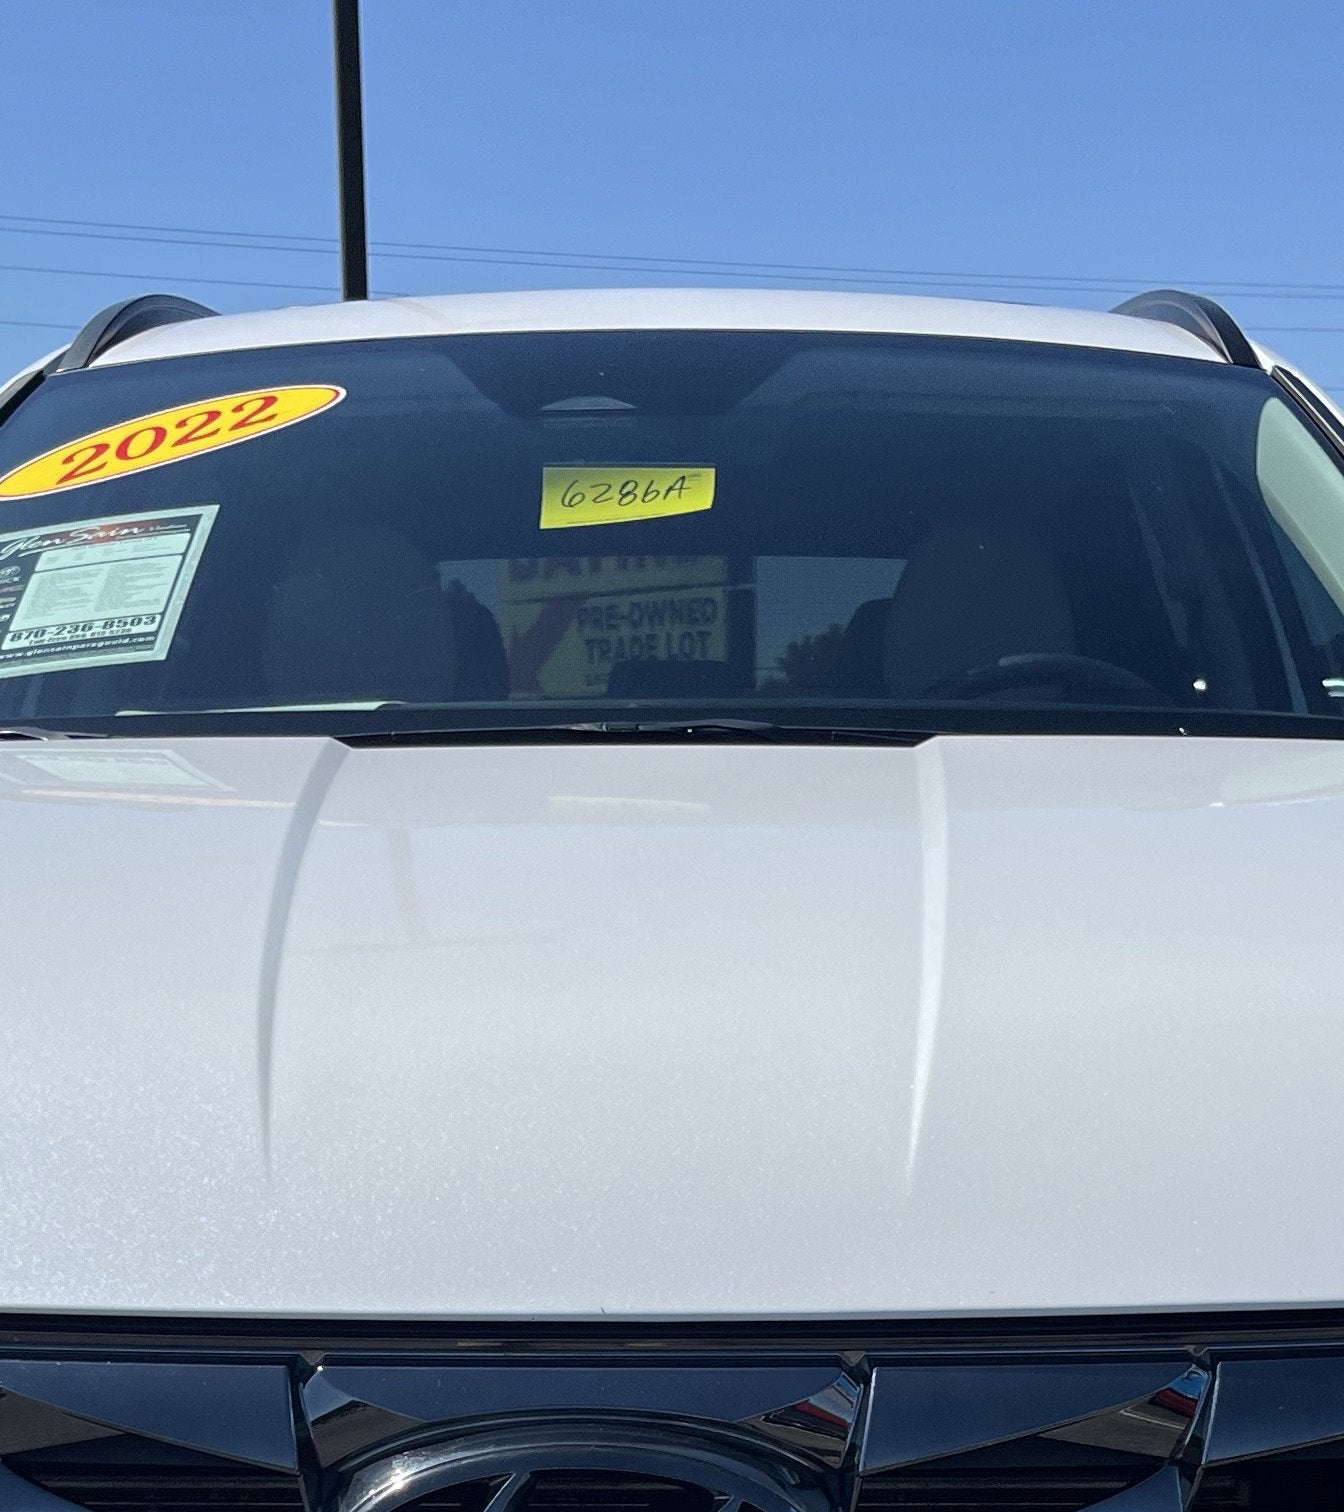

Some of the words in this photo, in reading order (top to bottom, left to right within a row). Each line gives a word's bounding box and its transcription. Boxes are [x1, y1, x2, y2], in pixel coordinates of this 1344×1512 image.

[56, 396, 278, 485] 2022
[561, 475, 691, 508] 6286A
[9, 615, 157, 643] 870-236-8503
[577, 597, 717, 632] PRE-OWNED
